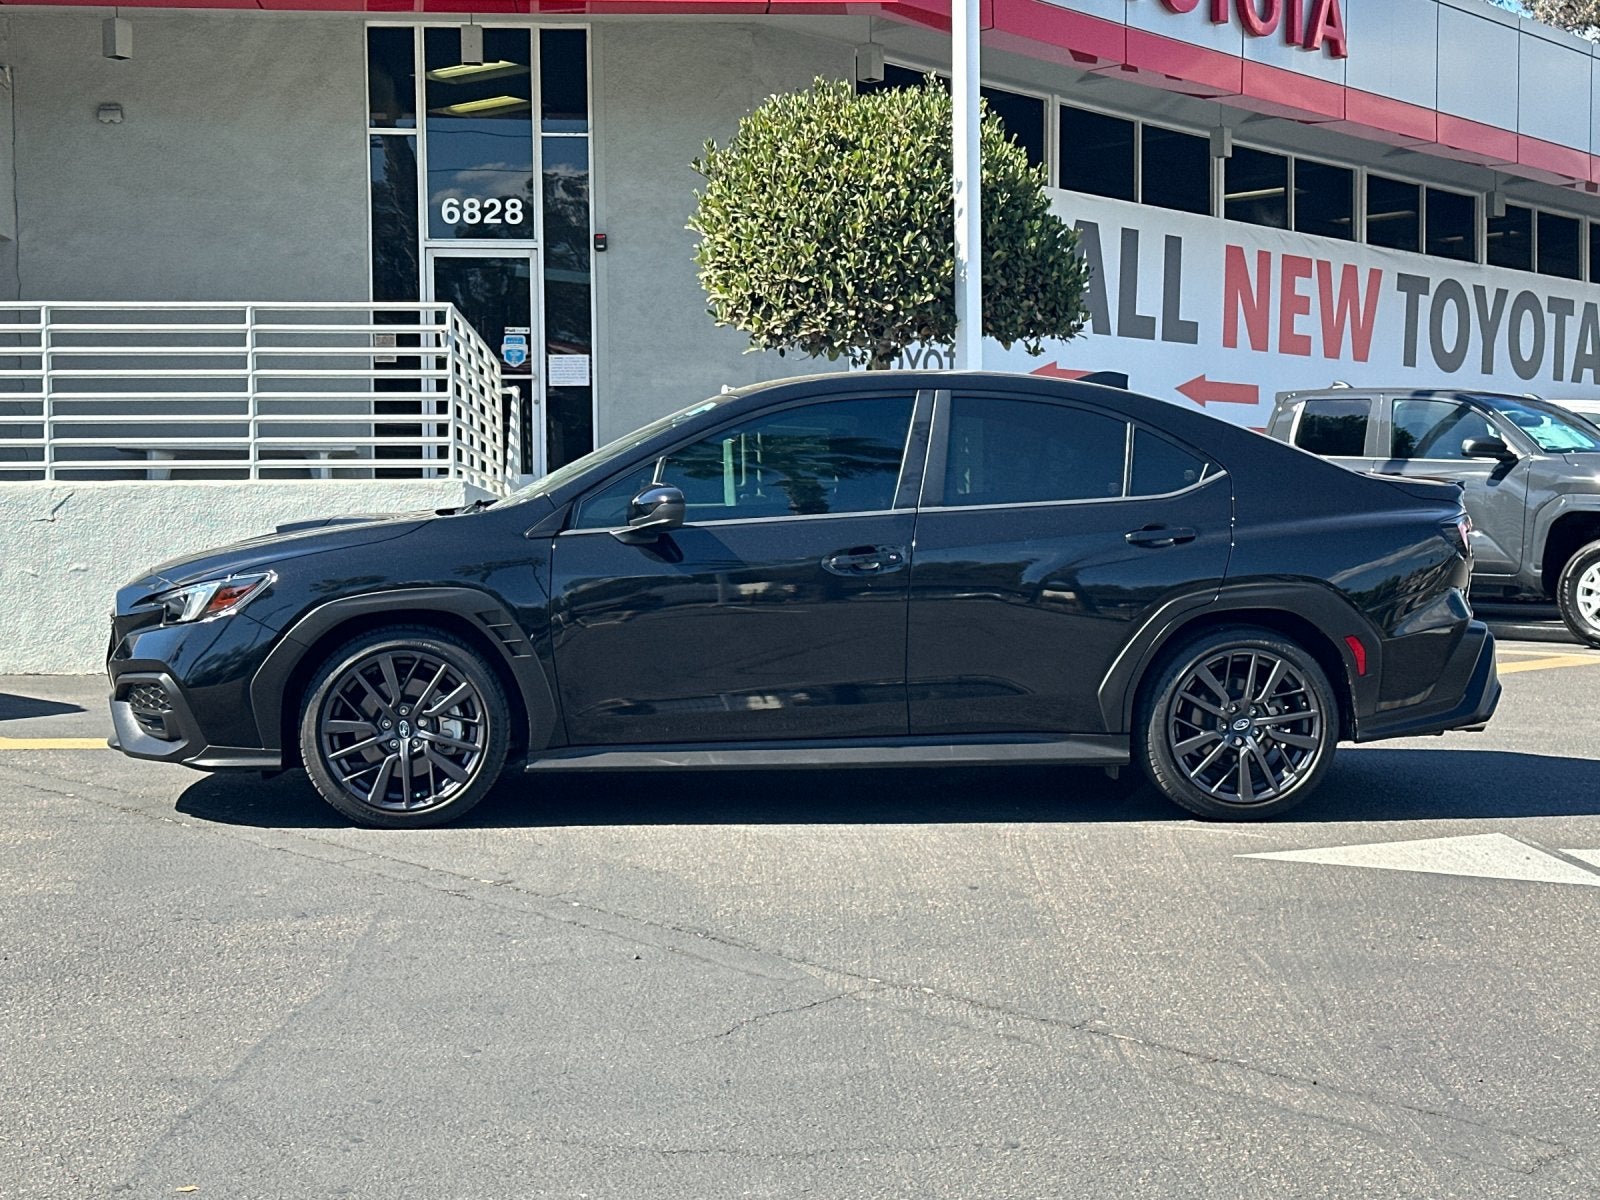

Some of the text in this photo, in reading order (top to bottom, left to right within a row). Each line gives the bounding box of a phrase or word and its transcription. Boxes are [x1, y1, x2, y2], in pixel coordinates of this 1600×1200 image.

[441, 198, 523, 224] 6828
[1073, 219, 1600, 385] ALL NEW TOYOTA
